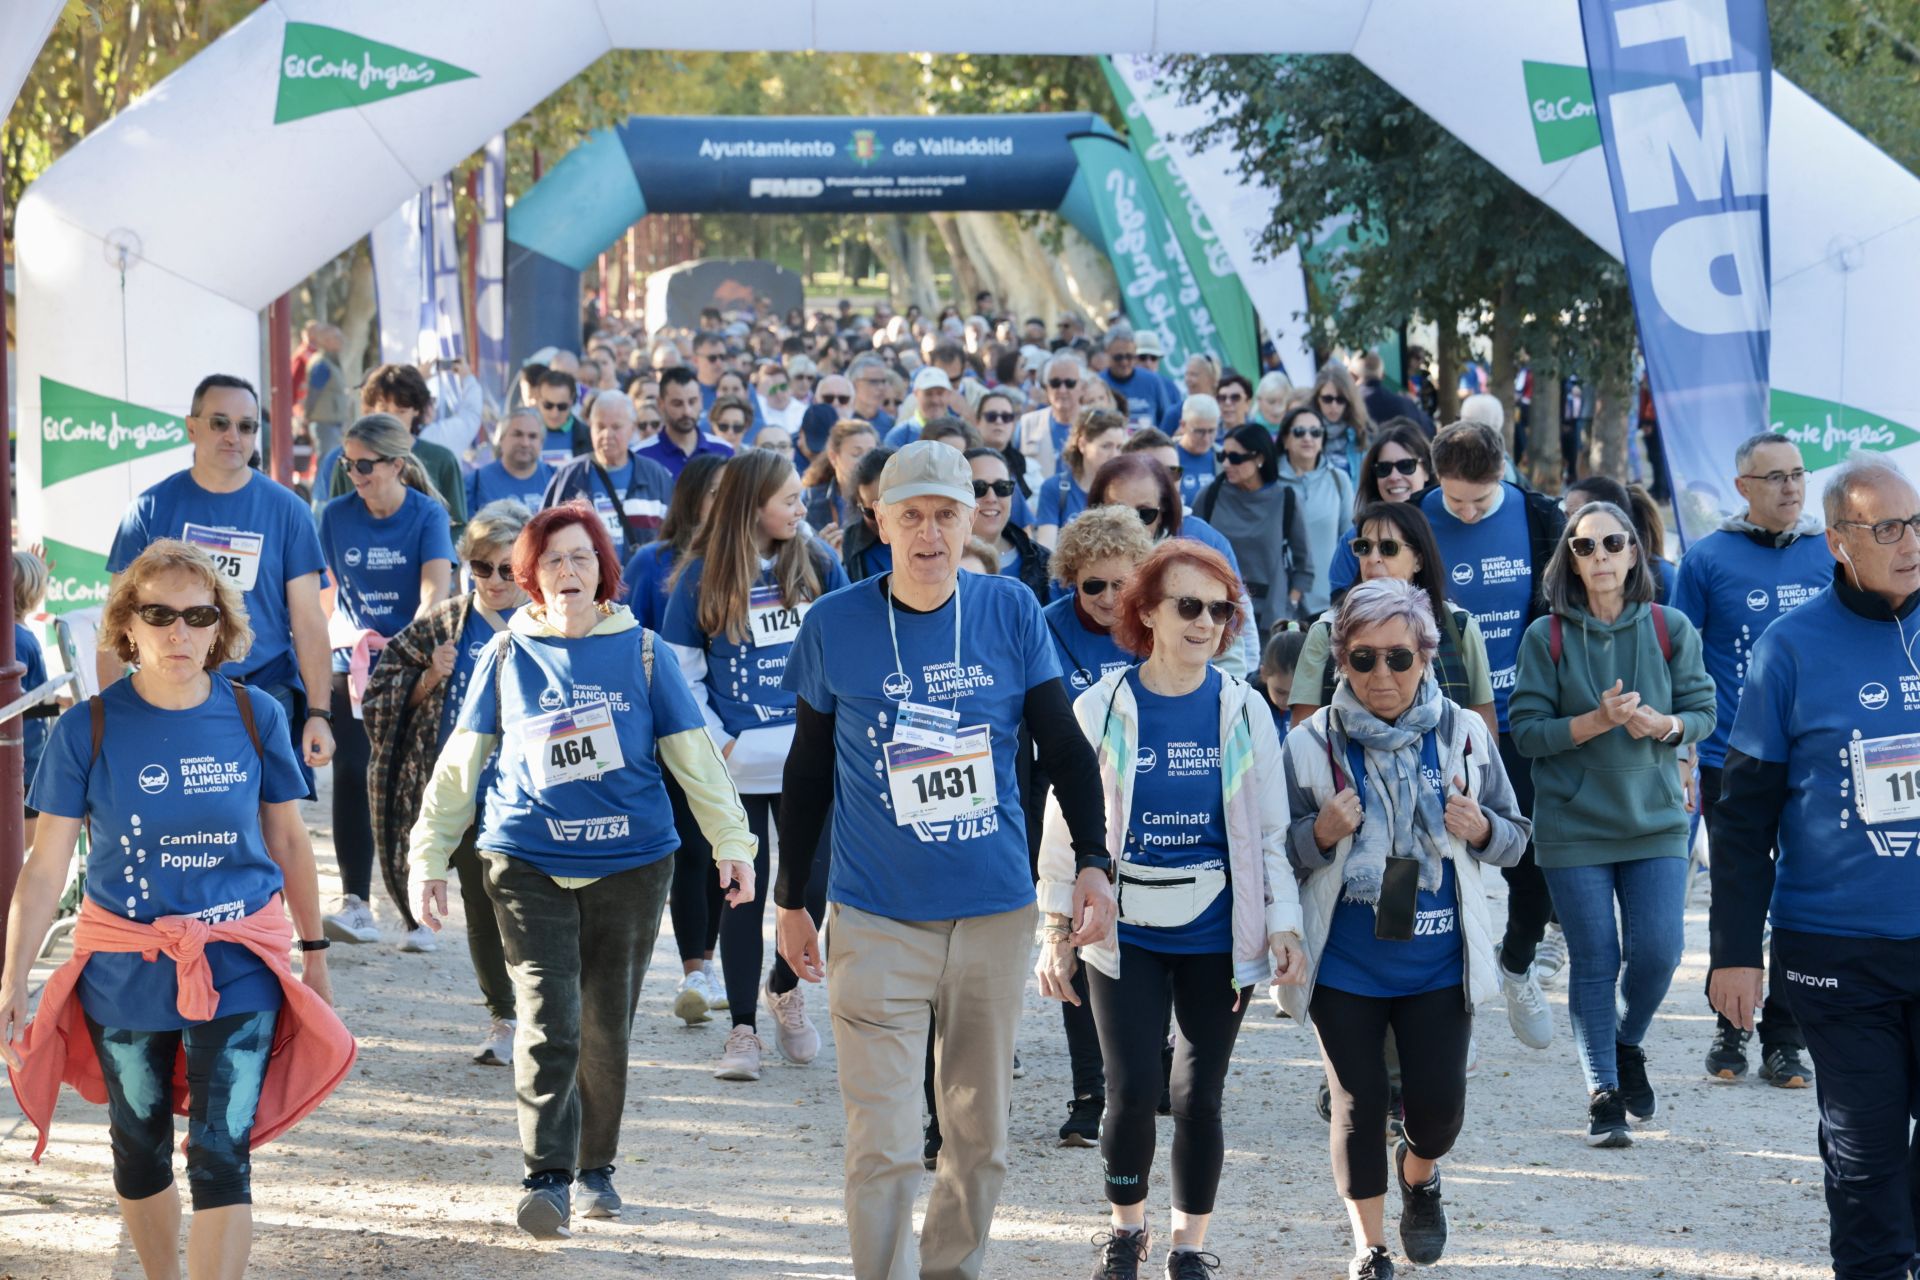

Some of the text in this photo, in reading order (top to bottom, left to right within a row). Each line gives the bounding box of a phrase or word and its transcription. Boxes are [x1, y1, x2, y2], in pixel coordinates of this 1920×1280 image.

[284, 51, 436, 90] El Corte Inglés
[1532, 96, 1597, 122] El Cor
[699, 137, 1014, 160] Ayuntamiento de Valladolid
[750, 174, 966, 198] FMD Fundación Municipal
[853, 187, 943, 197] de Deportes
[43, 411, 185, 450] El Corte Inglés
[1823, 414, 1896, 451] Inglés
[210, 554, 241, 577] 25
[1481, 559, 1525, 571] BANCO DE
[1483, 567, 1531, 579] ALIMENTOS
[1777, 588, 1807, 598] BANCO
[760, 607, 801, 633] 1124
[1481, 627, 1512, 640] pular
[924, 665, 984, 683] BANCO DE
[1493, 672, 1516, 689] ULS
[927, 675, 994, 694] ALIMENTOS
[572, 689, 622, 702] BANCO DE
[937, 689, 974, 701] VALLADOLID
[180, 755, 215, 765] FUNDACIÓN
[551, 735, 596, 769] 464
[1168, 747, 1220, 758] BANCO DE
[181, 761, 239, 776] BANCO DE
[1168, 758, 1221, 769] ALIMENTO
[183, 771, 248, 787] ALIMENTOS
[912, 764, 977, 804] 1431
[194, 786, 230, 794] VALLADOLID
[585, 815, 629, 825] COMERCIAL
[958, 813, 998, 840] ULSA
[1142, 811, 1210, 825] Caminata
[160, 830, 238, 846] Caminata
[585, 823, 630, 841] ULSA
[1143, 832, 1201, 847] Popular
[161, 852, 225, 872] Popular
[202, 899, 245, 918] COMERCIAL
[1416, 906, 1454, 919] COMERCIAL
[1414, 915, 1454, 935] ULSA
[1786, 970, 1838, 988] GIVOVA
